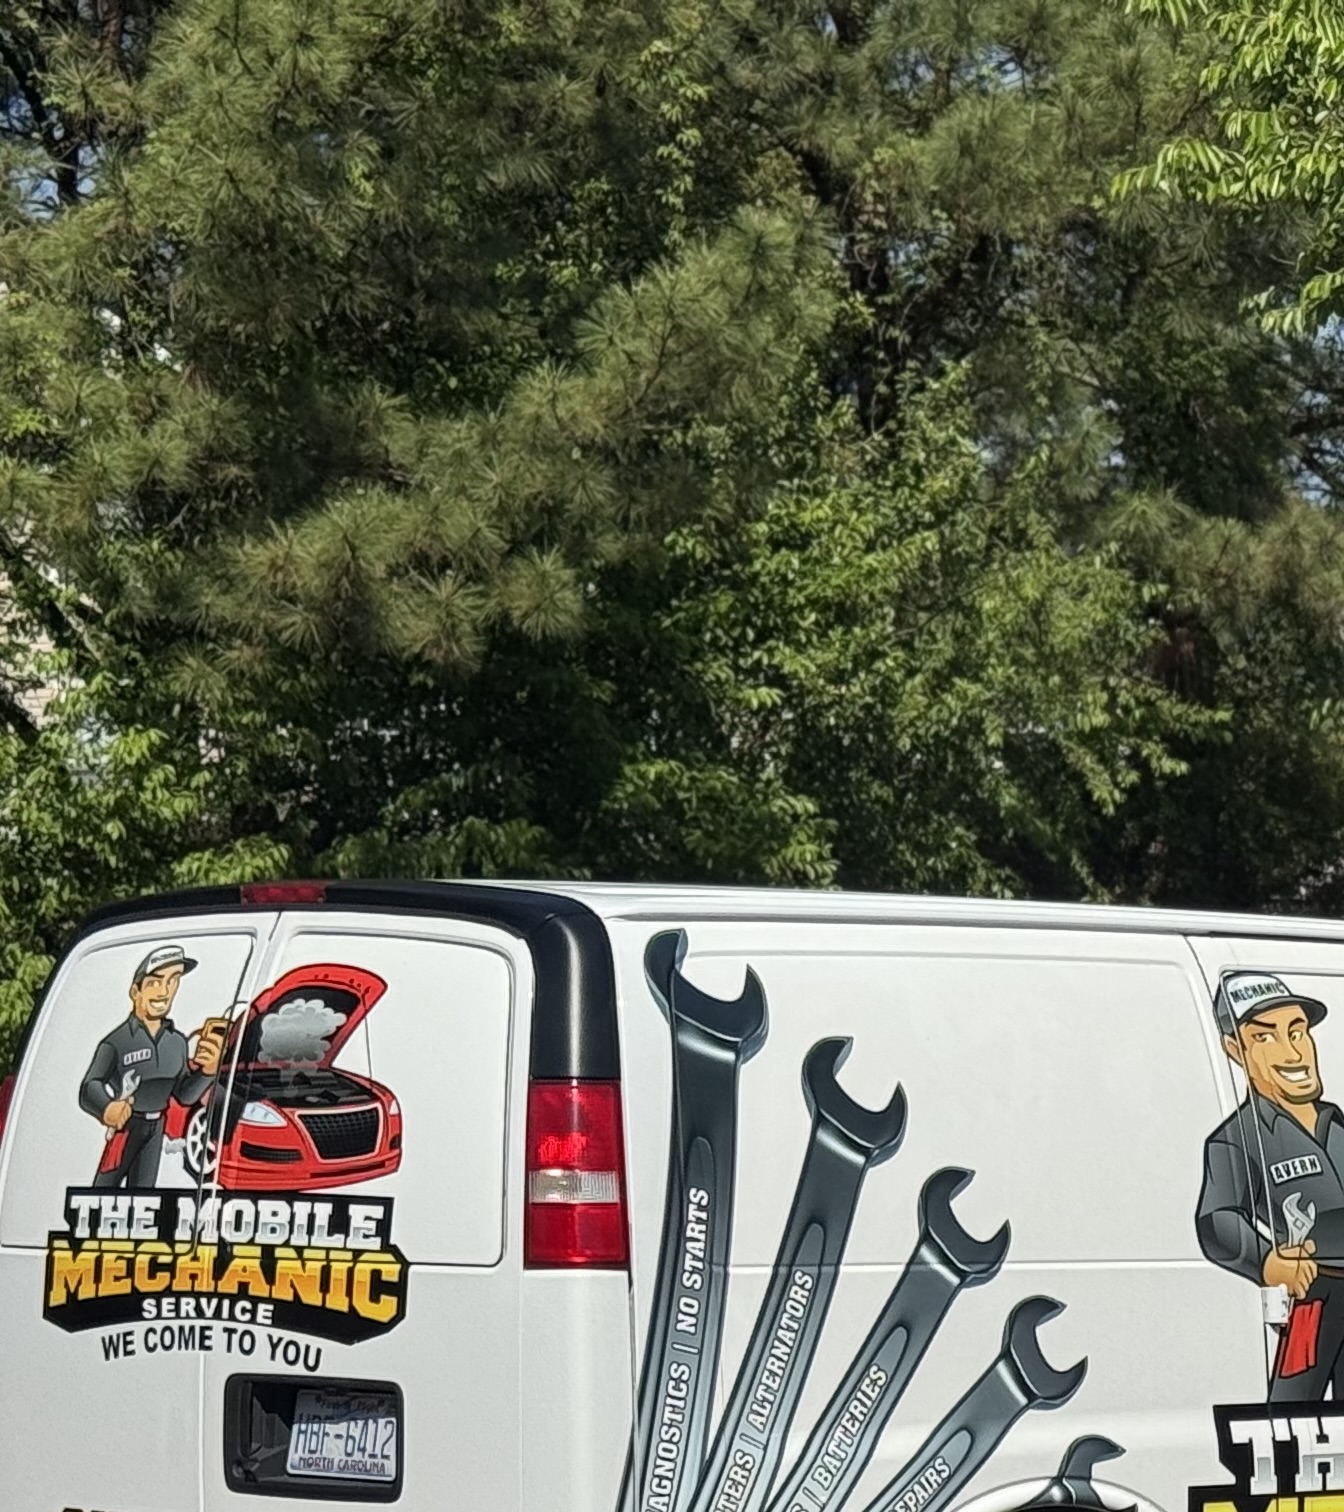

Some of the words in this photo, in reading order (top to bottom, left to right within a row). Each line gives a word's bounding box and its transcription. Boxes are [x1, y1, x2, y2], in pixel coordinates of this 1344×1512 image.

[1230, 981, 1285, 1003] MECHANIC
[1273, 1157, 1319, 1180] AVERN
[70, 1194, 161, 1240] THE
[174, 1196, 384, 1250] MOBILE
[682, 1187, 709, 1290] STARTS
[49, 1240, 402, 1323] MECHANIC
[141, 1297, 275, 1326] SERVICE
[676, 1297, 699, 1334] NO
[101, 1331, 136, 1361] WE
[144, 1326, 214, 1353] COME
[223, 1328, 256, 1356] TO
[266, 1334, 323, 1372] YOU
[746, 1270, 815, 1432] ALTERNATORS
[811, 1363, 890, 1491] BATTERIES
[299, 1456, 334, 1471] NORTH
[337, 1458, 387, 1474] CAROLINA
